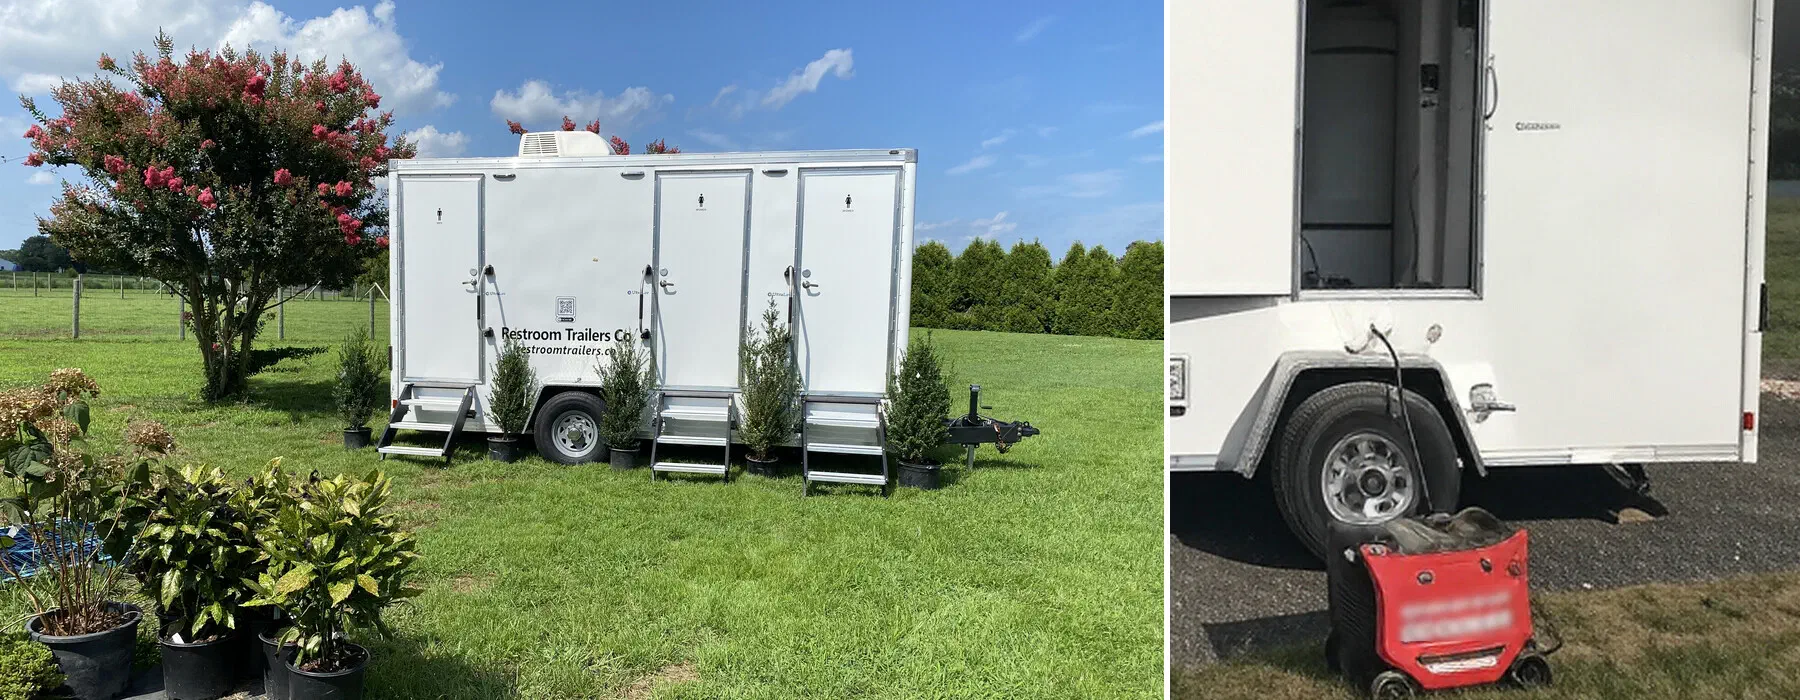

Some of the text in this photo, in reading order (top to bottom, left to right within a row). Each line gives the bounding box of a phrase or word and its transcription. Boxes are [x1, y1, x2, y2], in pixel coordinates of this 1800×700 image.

[501, 326, 632, 342] Restroom Trailers Co
